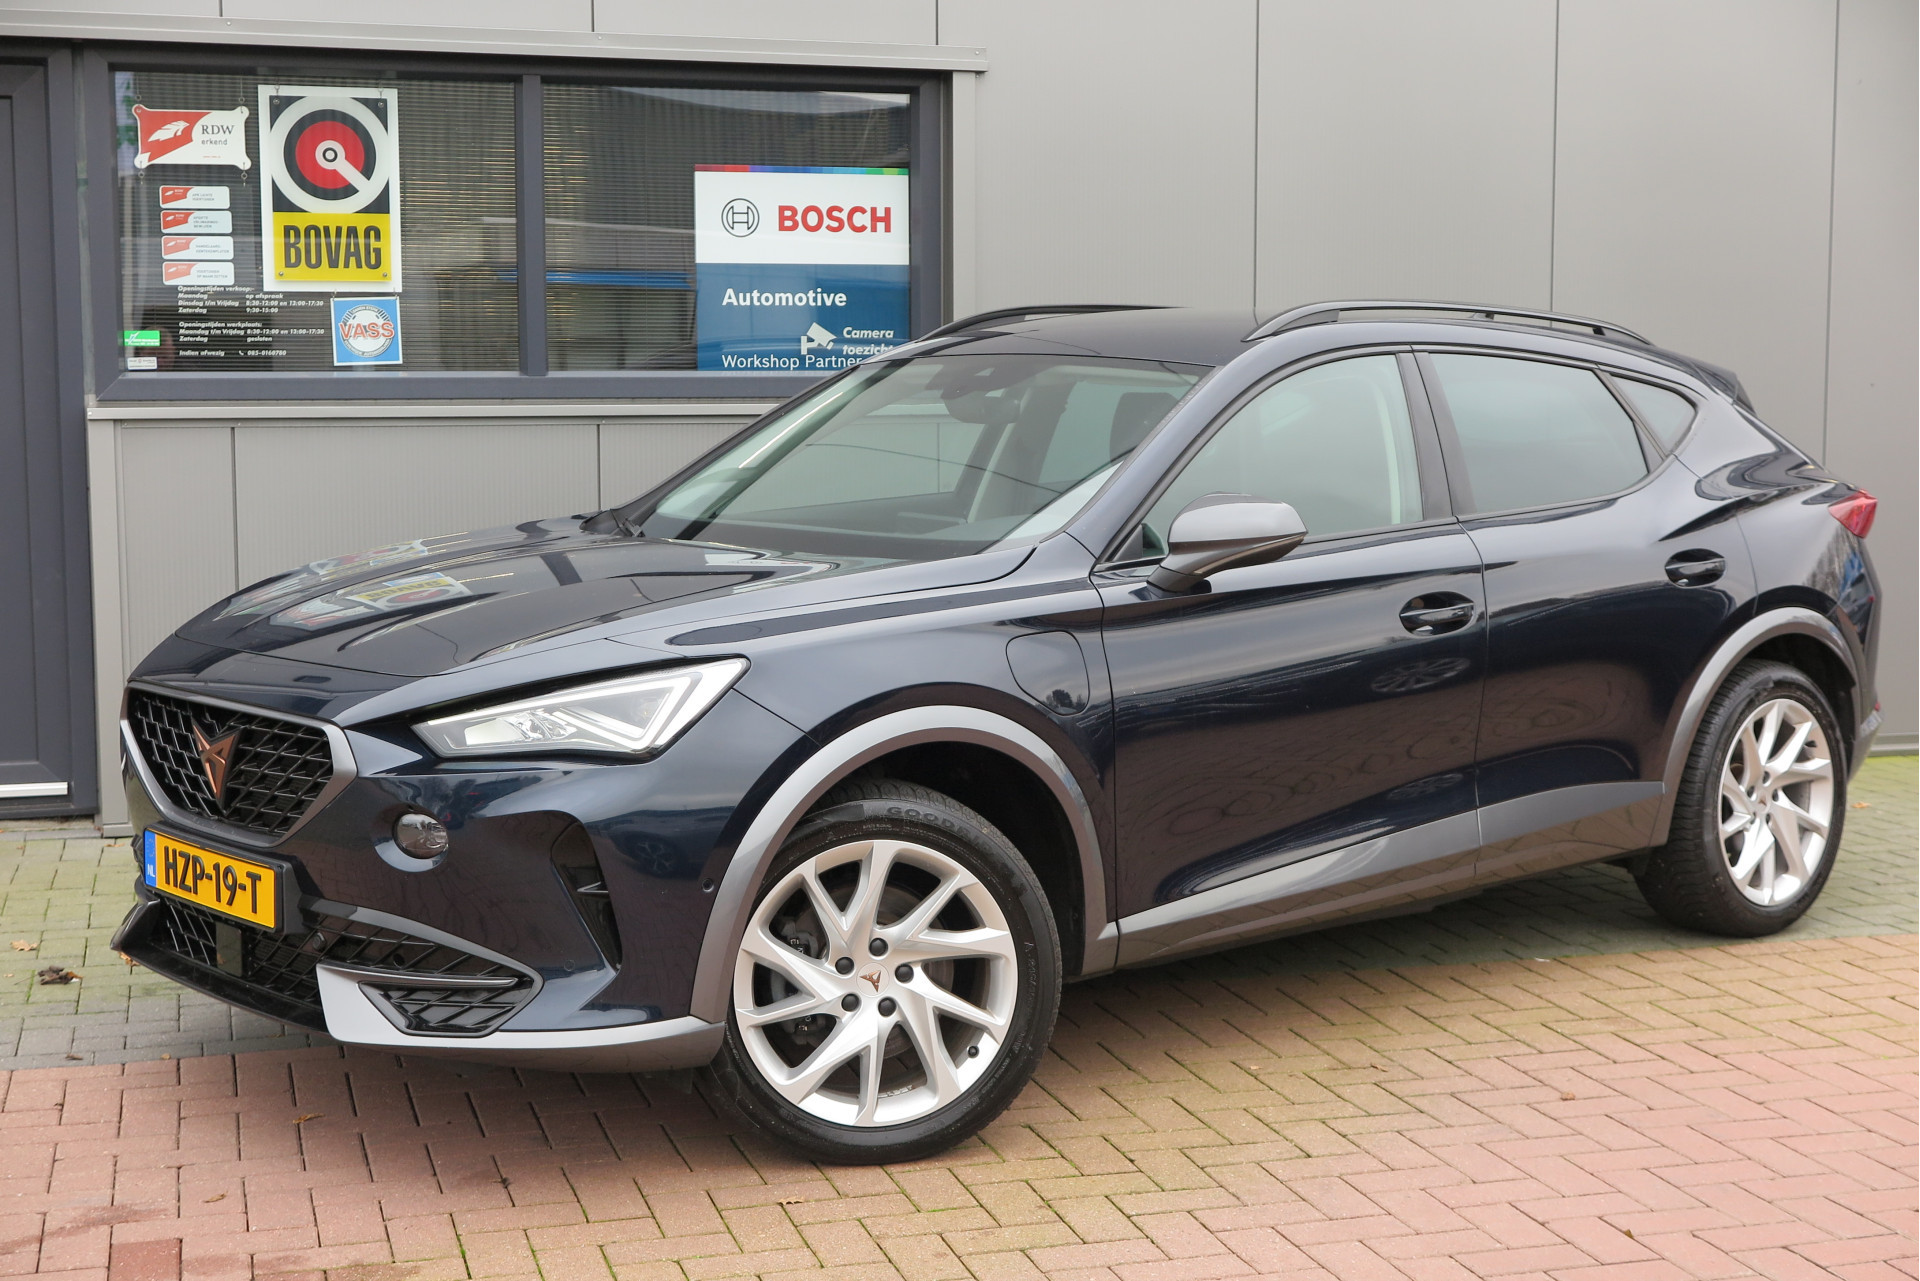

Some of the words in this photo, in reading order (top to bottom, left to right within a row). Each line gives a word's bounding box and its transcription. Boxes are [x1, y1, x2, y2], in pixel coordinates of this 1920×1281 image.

[201, 124, 235, 135] RDW
[201, 138, 228, 146] erkend
[778, 204, 892, 233] BOSCH
[283, 224, 382, 270] BOVAG
[721, 288, 847, 307] Automotive
[338, 321, 395, 340] VASS
[843, 326, 894, 339] Camera
[721, 354, 800, 371] Workshop
[805, 354, 863, 369] Partner
[147, 863, 156, 878] NL
[163, 845, 262, 915] HZP-19-T
